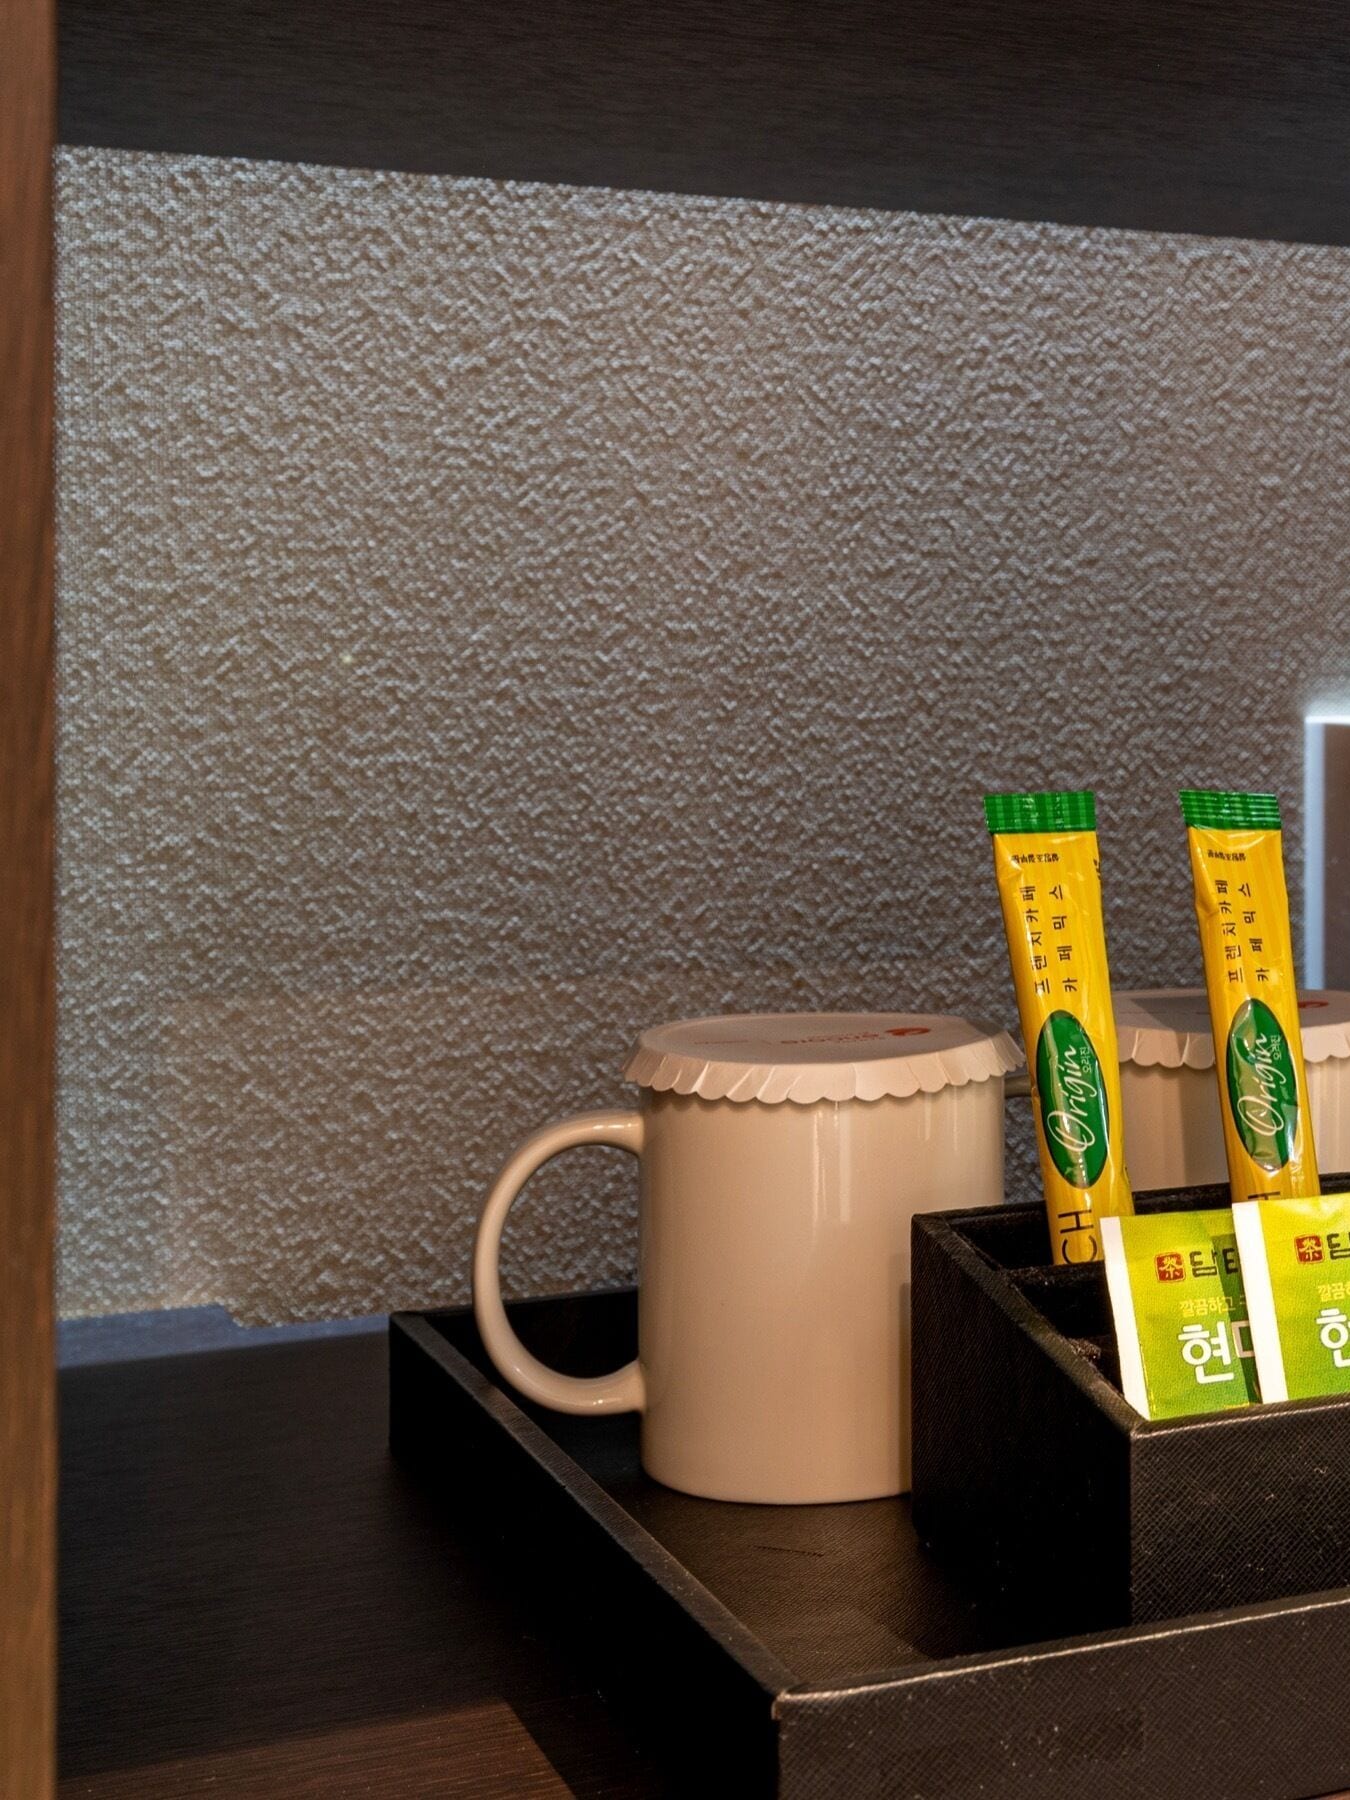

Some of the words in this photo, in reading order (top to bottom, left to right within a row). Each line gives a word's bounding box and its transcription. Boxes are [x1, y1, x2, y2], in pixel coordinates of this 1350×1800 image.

[1049, 885, 1078, 992] 카페믹스
[1215, 880, 1244, 983] 프렌치카페
[1238, 883, 1269, 982] 카페믹스
[1047, 1044, 1098, 1152] Origin
[1079, 1046, 1093, 1073] 오리진
[1237, 1032, 1287, 1136] Origin
[1180, 1295, 1236, 1318] 깔끔하고
